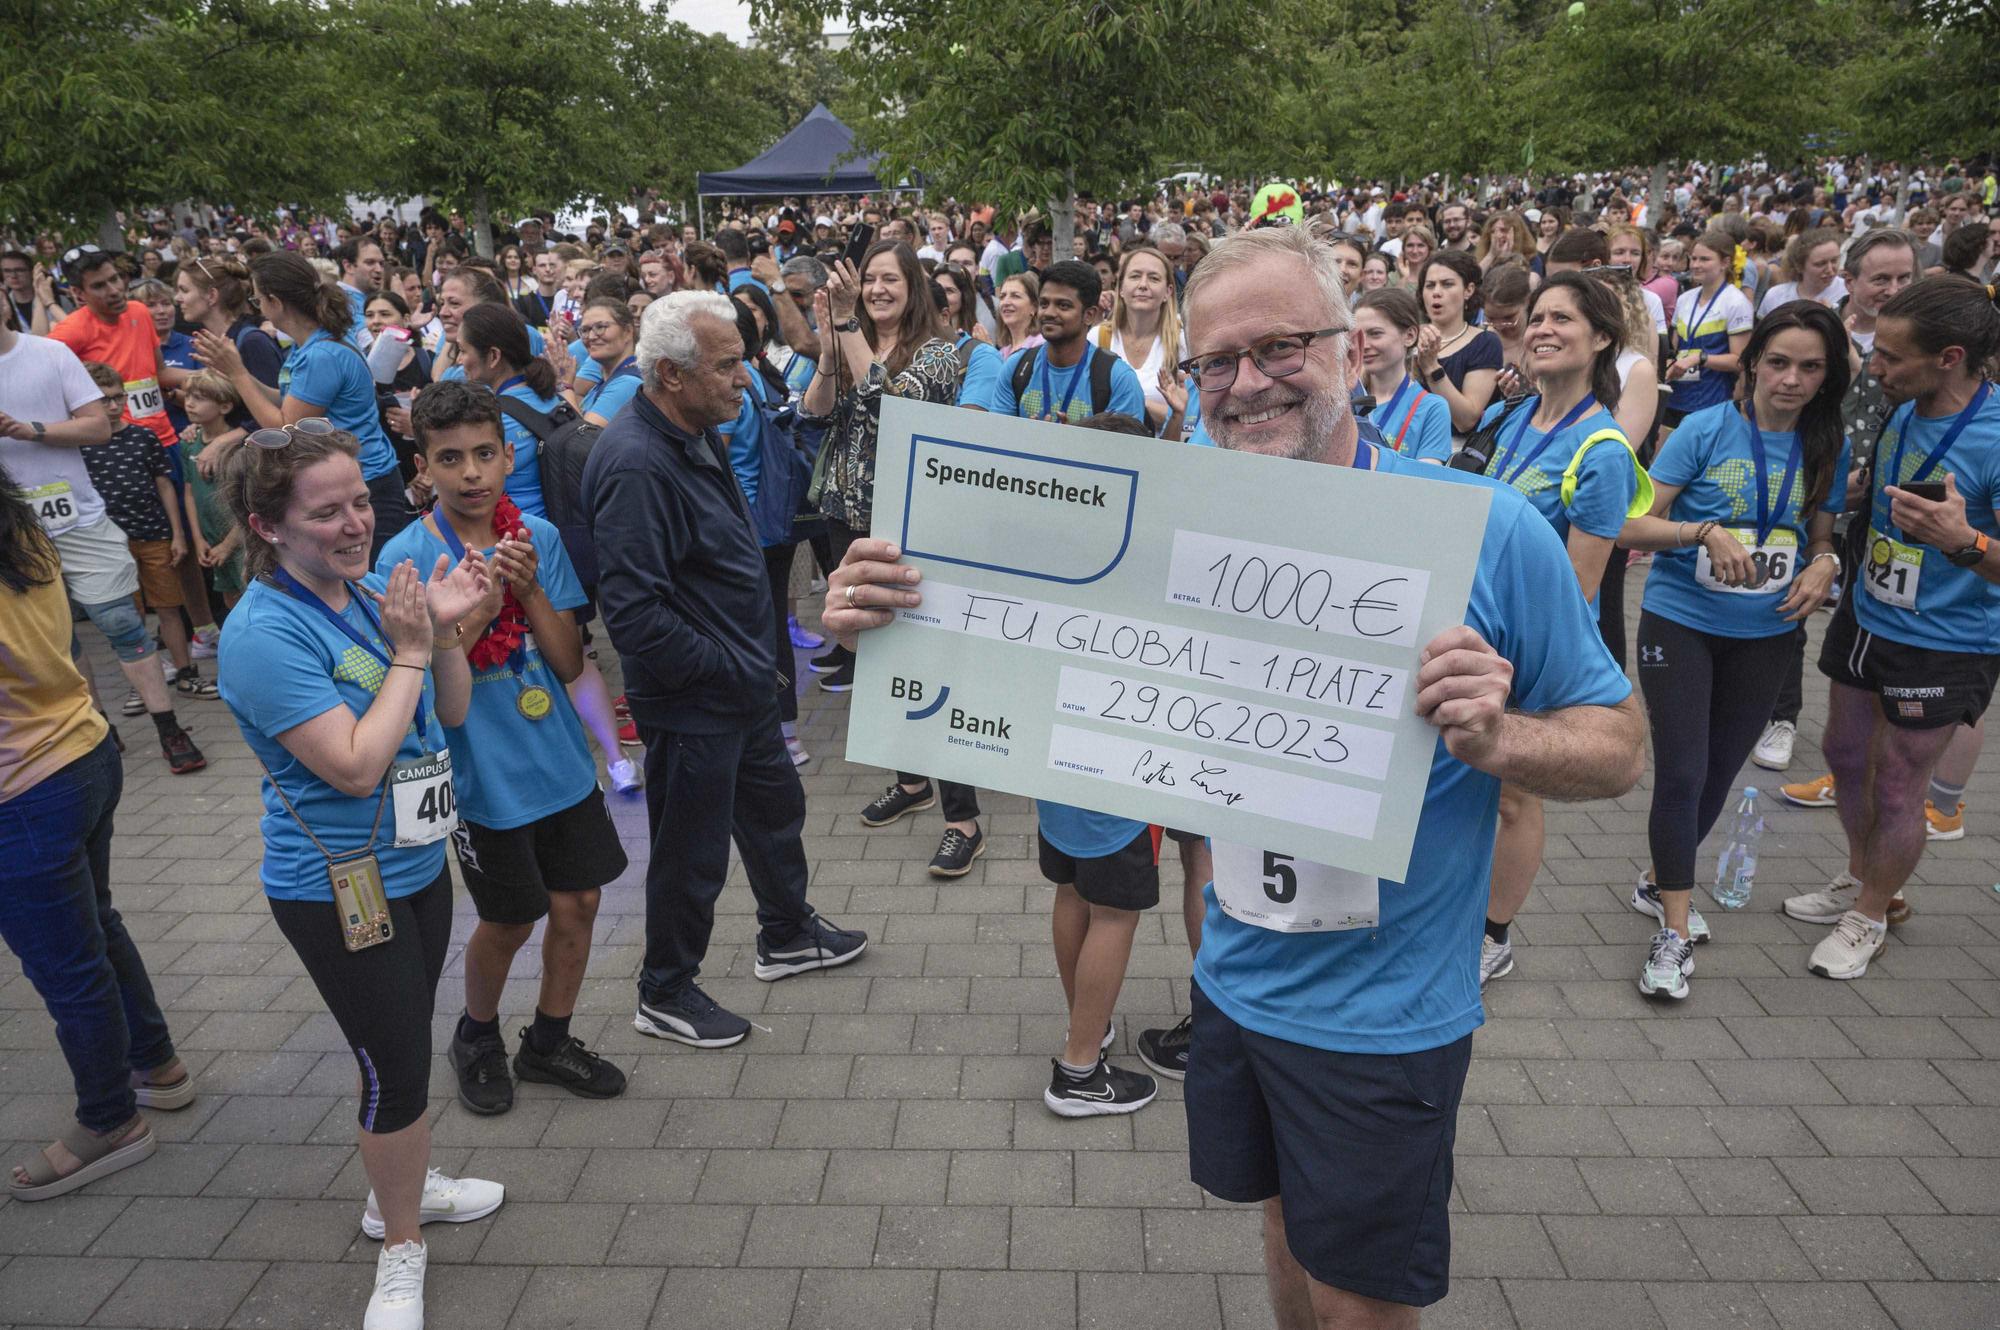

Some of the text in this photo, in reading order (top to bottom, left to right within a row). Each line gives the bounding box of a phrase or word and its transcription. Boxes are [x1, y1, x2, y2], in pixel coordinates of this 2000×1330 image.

[925, 457, 1106, 508] Spendenscheck
[1896, 552, 1917, 563] 2023
[1173, 592, 1201, 604] BETRAG
[902, 611, 941, 625] ZUGUNSTEN
[962, 594, 1039, 643] FU
[1056, 614, 1225, 679] GLOBAL
[891, 676, 923, 702] BB
[1062, 702, 1086, 712] DATUM
[949, 708, 1012, 740] Bank
[1100, 680, 1349, 763] 29.06.2023
[947, 735, 1010, 757] Better Banking
[397, 761, 443, 781] CAMPUS
[1054, 759, 1104, 776] UNTERSCHRIFT
[1263, 850, 1298, 904] 5
